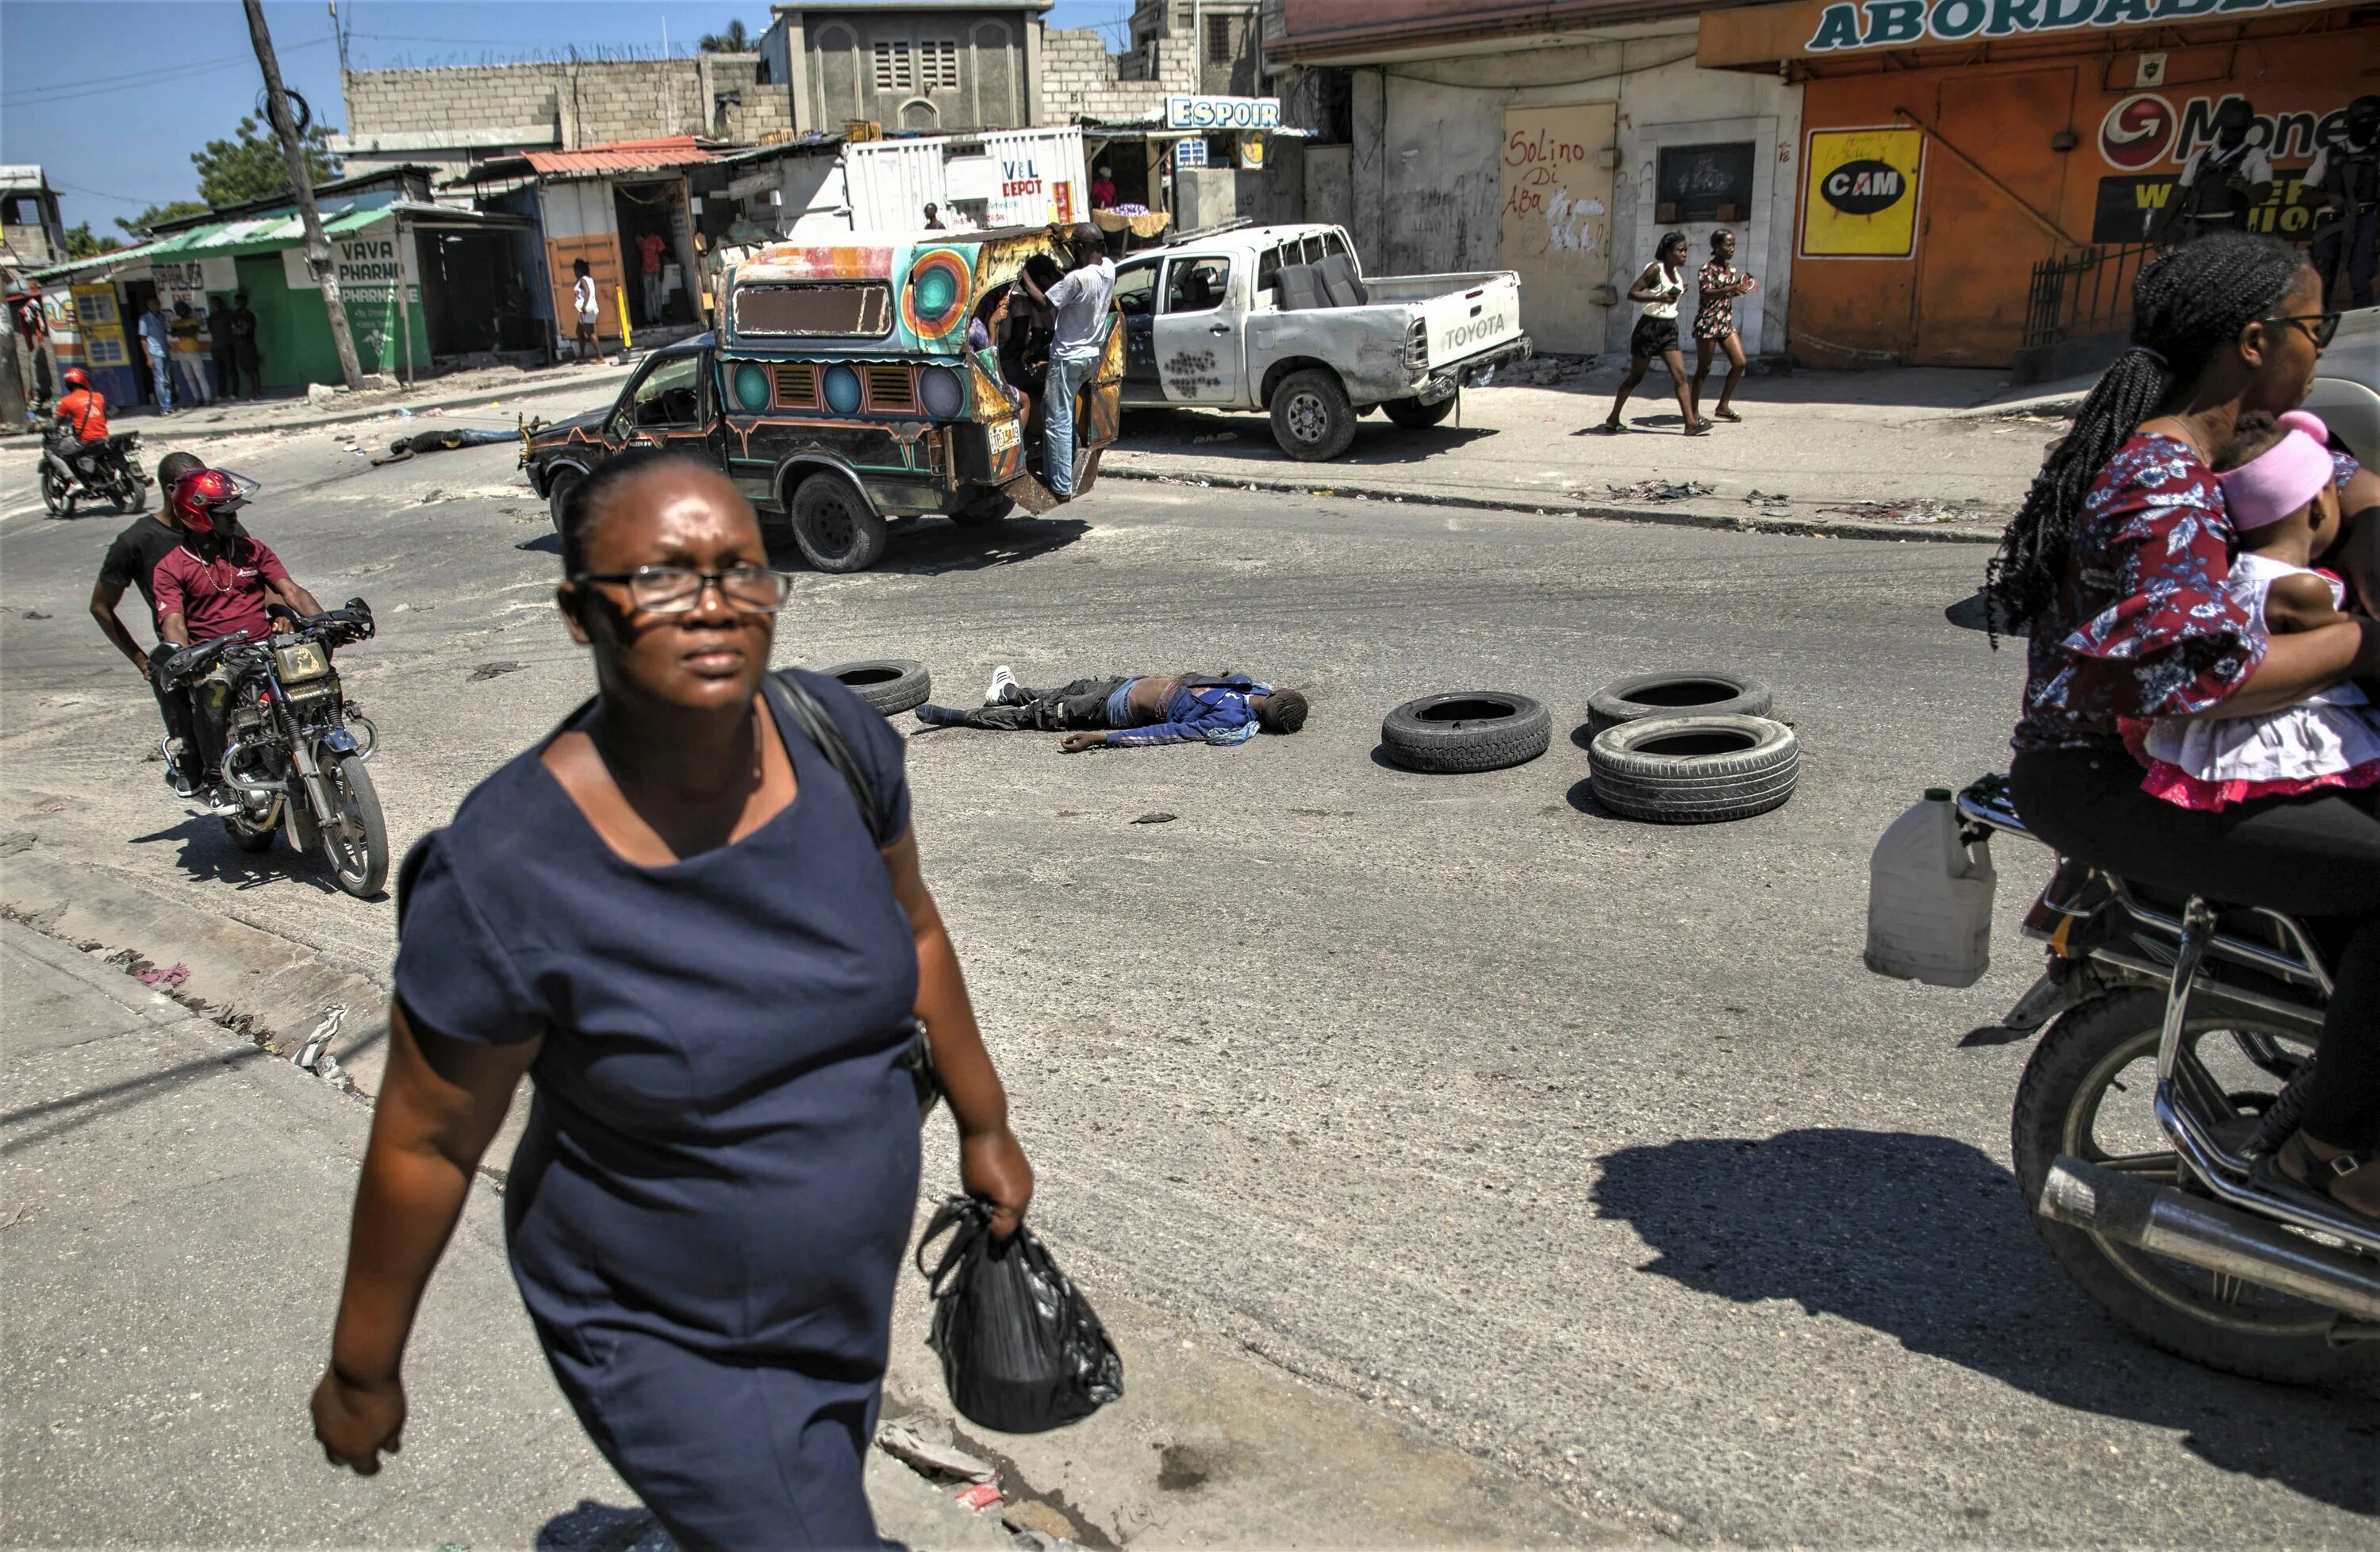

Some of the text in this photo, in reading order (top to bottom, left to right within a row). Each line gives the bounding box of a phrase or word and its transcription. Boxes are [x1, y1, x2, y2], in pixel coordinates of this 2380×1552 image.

[1804, 0, 2326, 52] ABORDA
[1173, 99, 1279, 126] ESPOIR
[2172, 94, 2350, 163] Mone
[1003, 161, 1015, 180] V
[1028, 160, 1038, 179] L
[1829, 171, 1898, 196] CAM
[341, 241, 393, 260] VAVA
[343, 287, 419, 303] PHARMAE
[1445, 313, 1504, 349] TOYOTA
